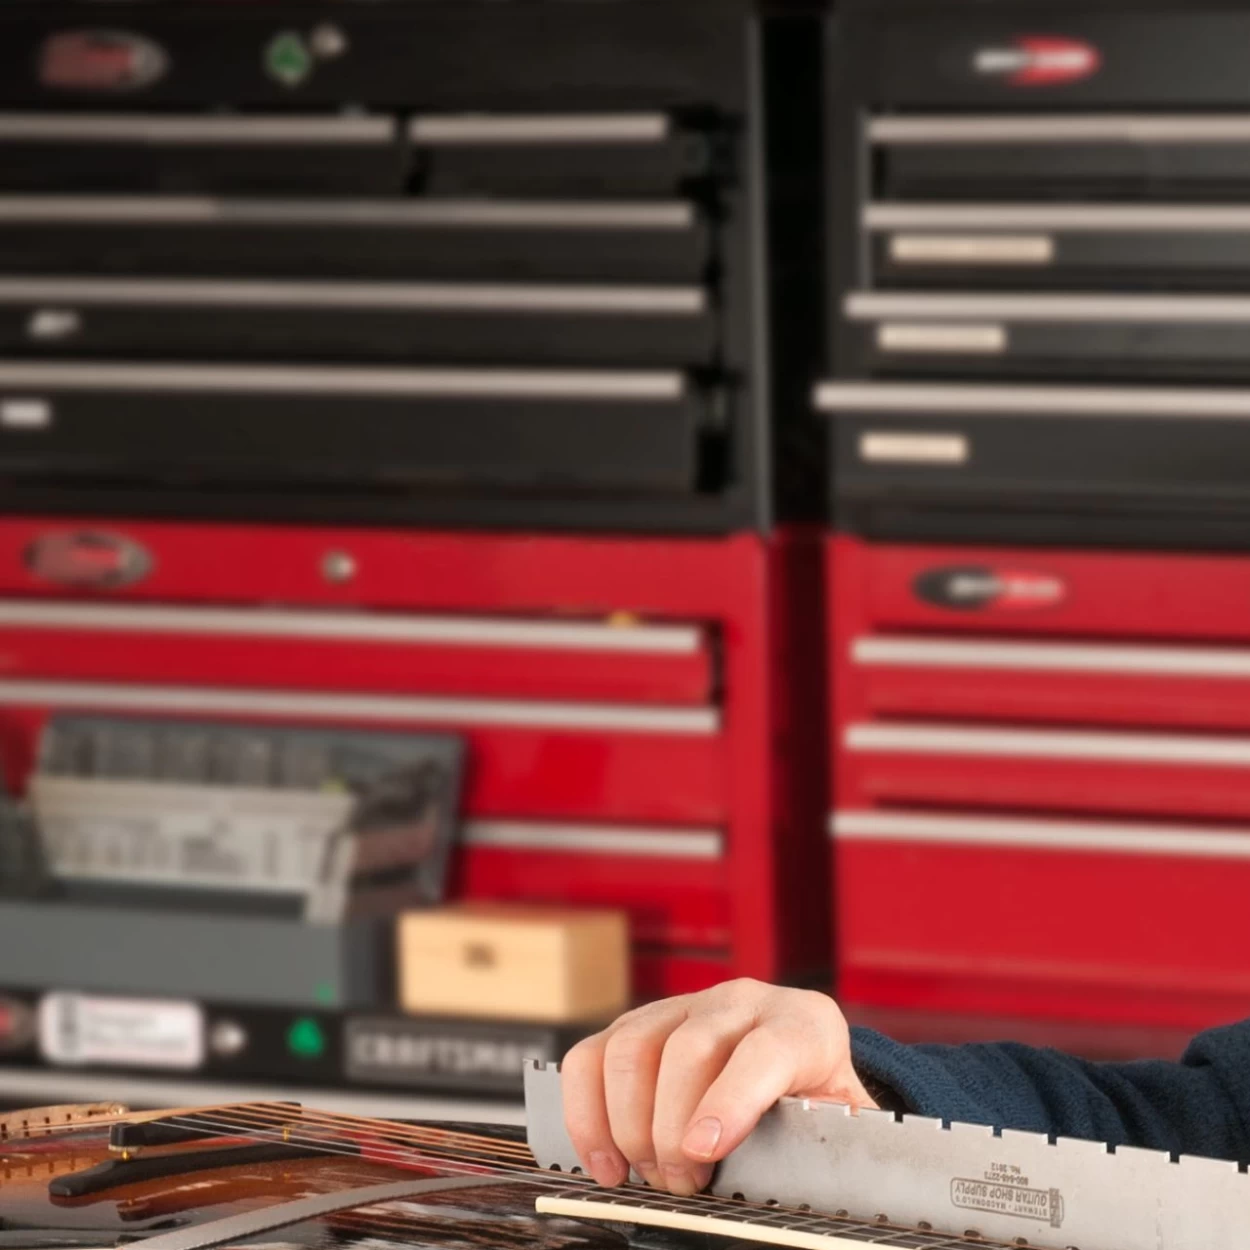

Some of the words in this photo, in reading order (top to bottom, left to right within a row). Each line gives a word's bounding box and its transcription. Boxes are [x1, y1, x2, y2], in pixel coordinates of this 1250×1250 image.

[955, 1182, 988, 1197] SUPPLY
[989, 1187, 1014, 1201] SHOP
[1015, 1191, 1047, 1206] GUITAR
